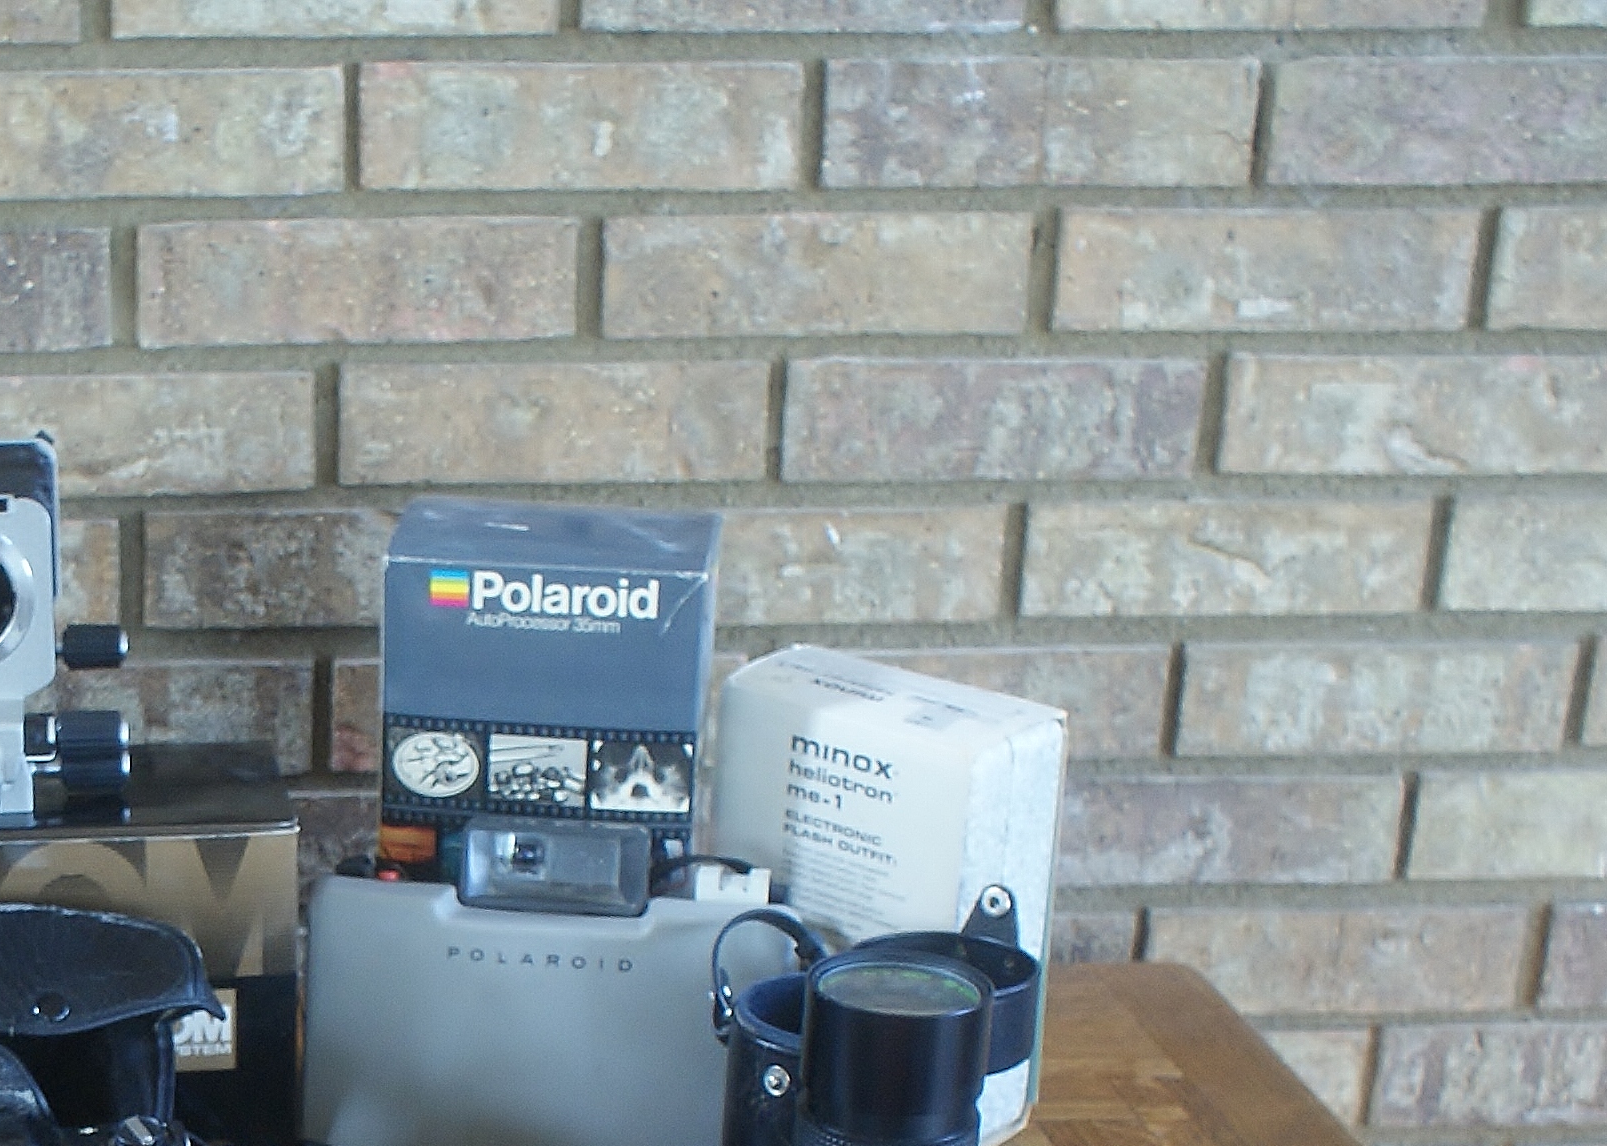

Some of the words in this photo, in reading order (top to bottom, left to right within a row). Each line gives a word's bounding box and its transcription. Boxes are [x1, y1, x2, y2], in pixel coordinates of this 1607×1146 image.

[472, 569, 660, 620] Polaroid
[466, 612, 571, 632] AutoProcessor
[791, 734, 893, 779] minox
[786, 783, 843, 809] me-1
[789, 759, 894, 803] heliotron
[785, 808, 882, 846] ELECTRONIC
[447, 946, 633, 973] POLAROID
